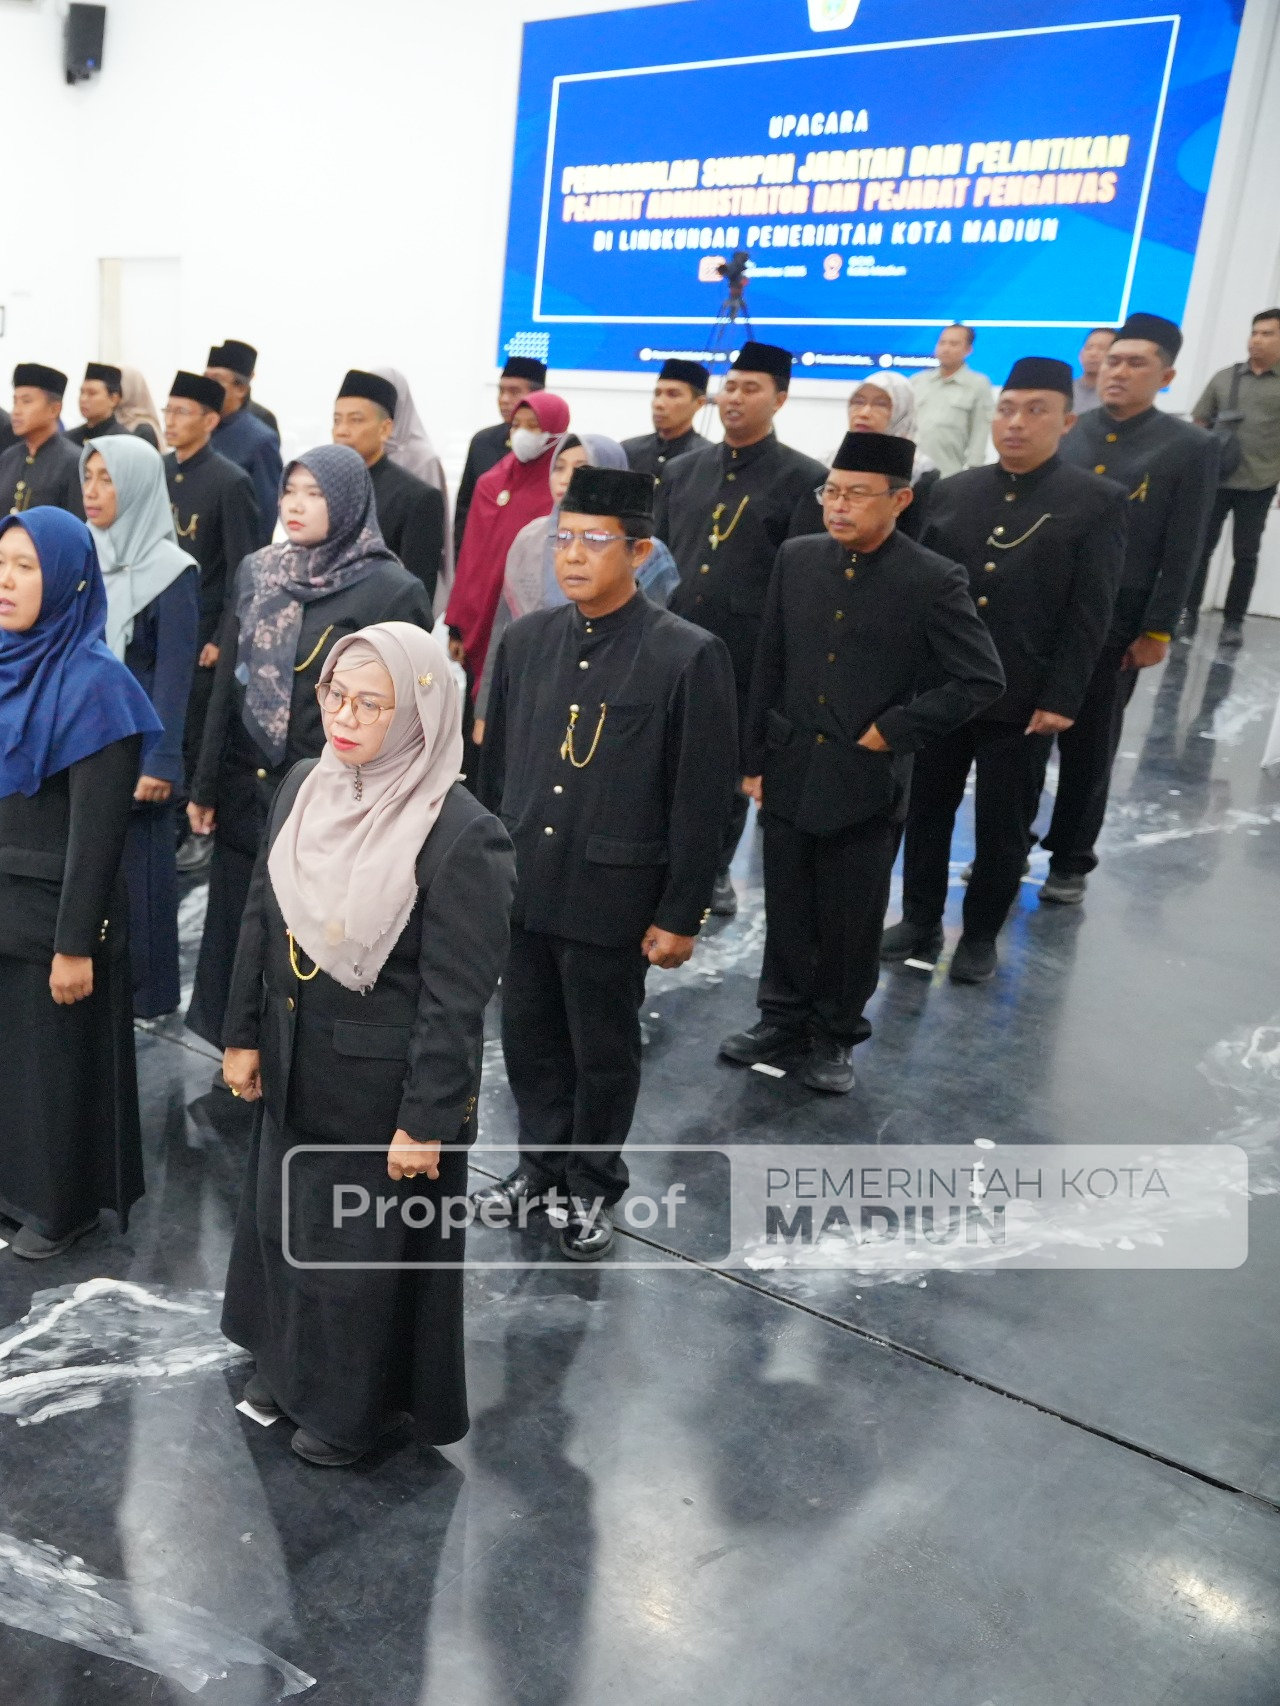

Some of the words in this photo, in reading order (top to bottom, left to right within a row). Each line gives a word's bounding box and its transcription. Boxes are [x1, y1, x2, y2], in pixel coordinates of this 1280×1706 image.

[769, 109, 868, 138] UPACARA
[908, 143, 963, 177] DAN
[966, 134, 1130, 174] PELANTIKAN
[863, 177, 970, 211] PEJABAT
[973, 171, 1118, 207] PENGAWAS
[593, 230, 613, 251] DI
[746, 222, 883, 248] PEMERINTAH
[891, 220, 951, 245] KOTA
[961, 217, 1059, 243] MADIUN
